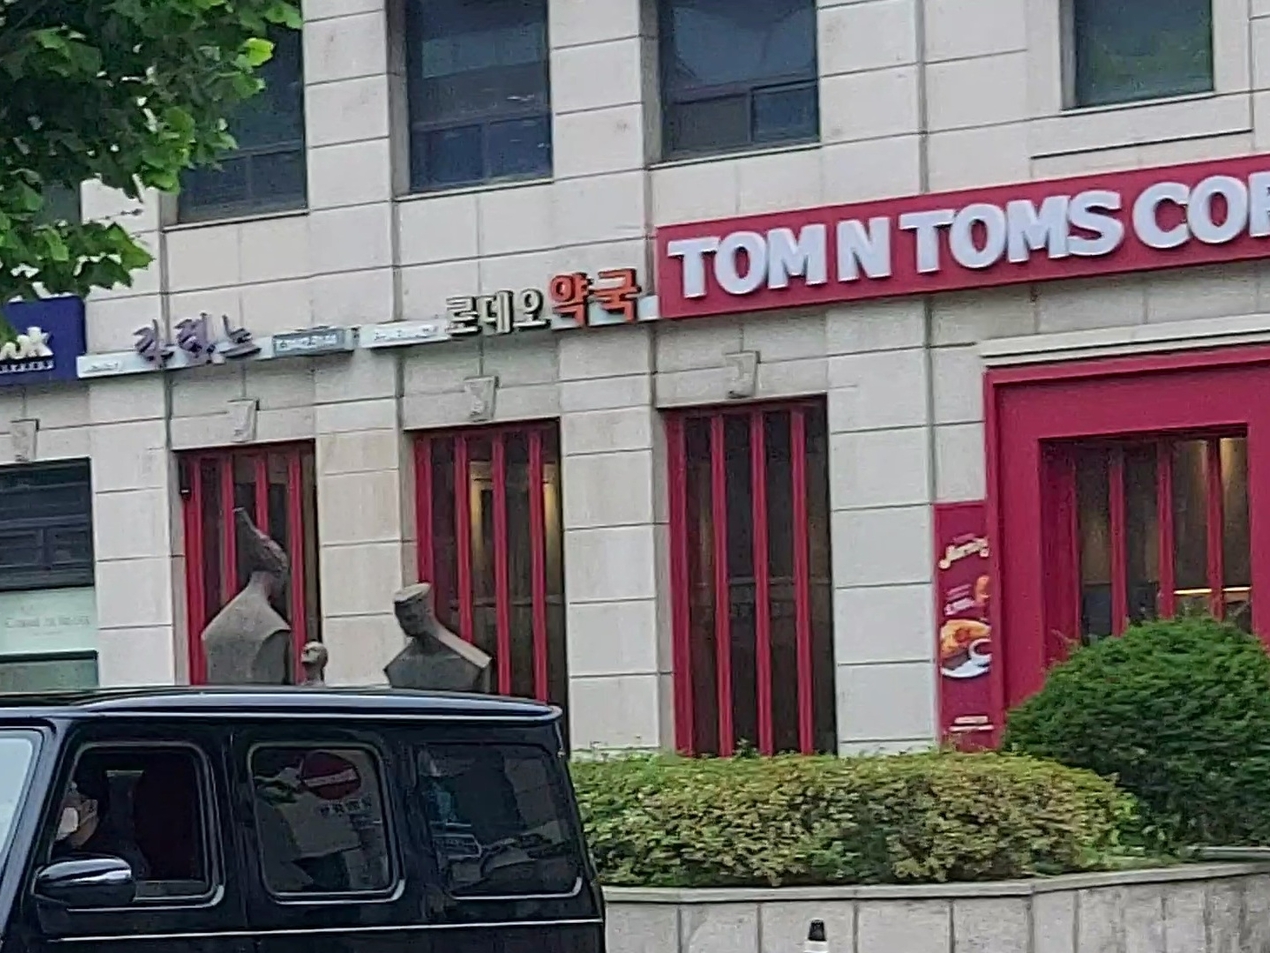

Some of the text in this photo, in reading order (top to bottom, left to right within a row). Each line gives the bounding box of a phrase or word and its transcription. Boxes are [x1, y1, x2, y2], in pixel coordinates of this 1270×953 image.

[668, 223, 827, 298] TOM
[836, 216, 891, 282] N
[899, 190, 1124, 273] TOMS
